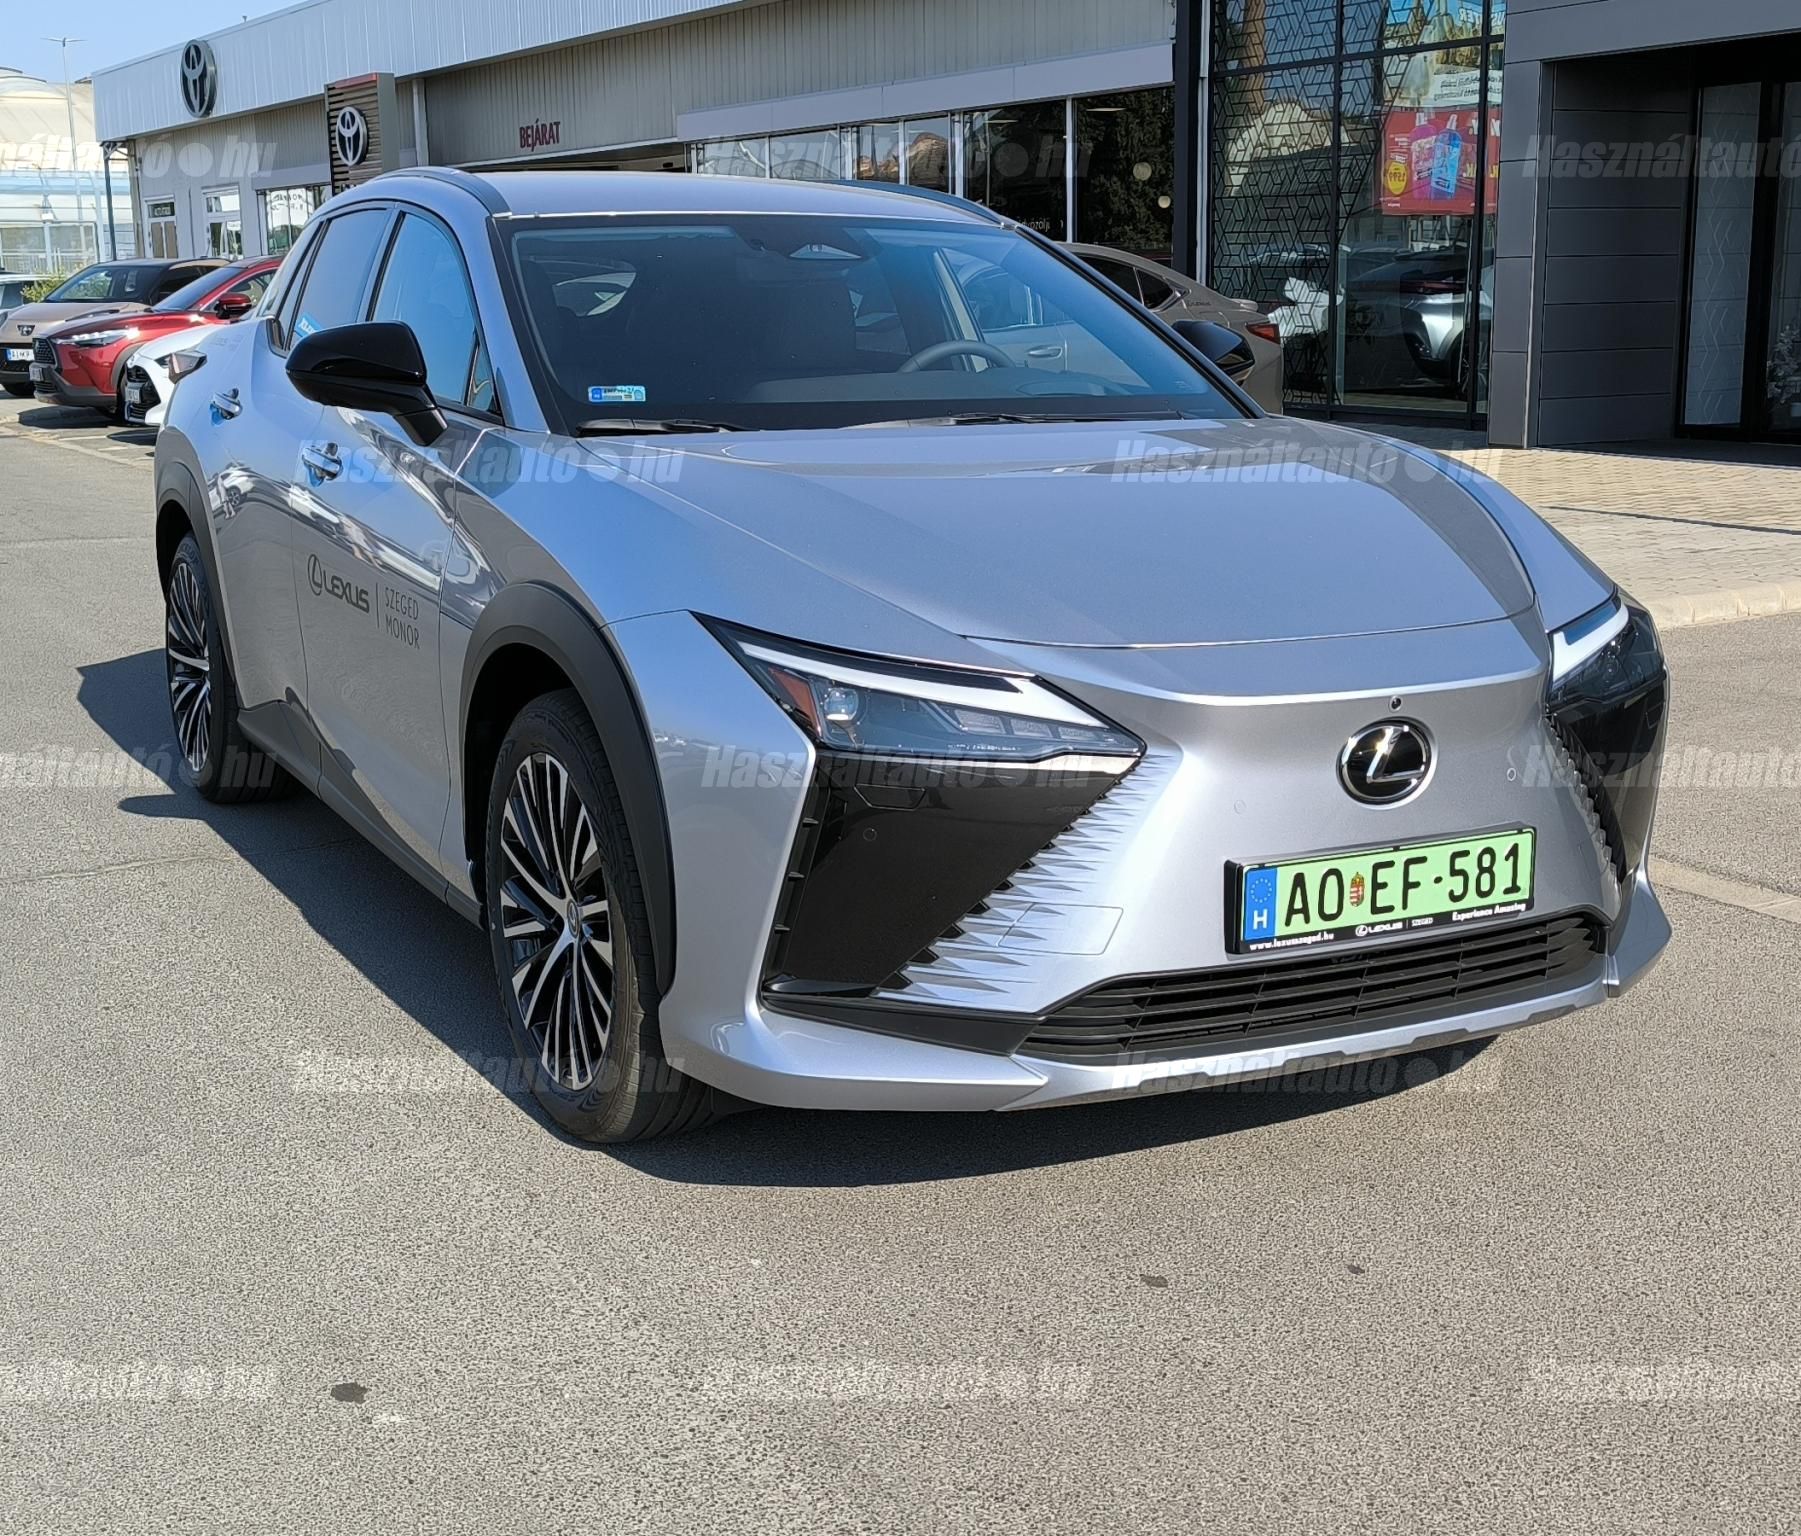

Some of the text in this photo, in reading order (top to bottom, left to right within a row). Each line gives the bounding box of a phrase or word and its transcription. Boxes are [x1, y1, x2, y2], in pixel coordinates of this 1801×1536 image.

[519, 117, 561, 152] BEJÁRAT
[323, 569, 370, 614] LEXUS
[385, 587, 419, 621] SZEGED
[385, 614, 420, 650] MONOR
[1253, 908, 1268, 930] H
[1284, 867, 1345, 927] AO
[1452, 902, 1527, 922] Experience Amazing
